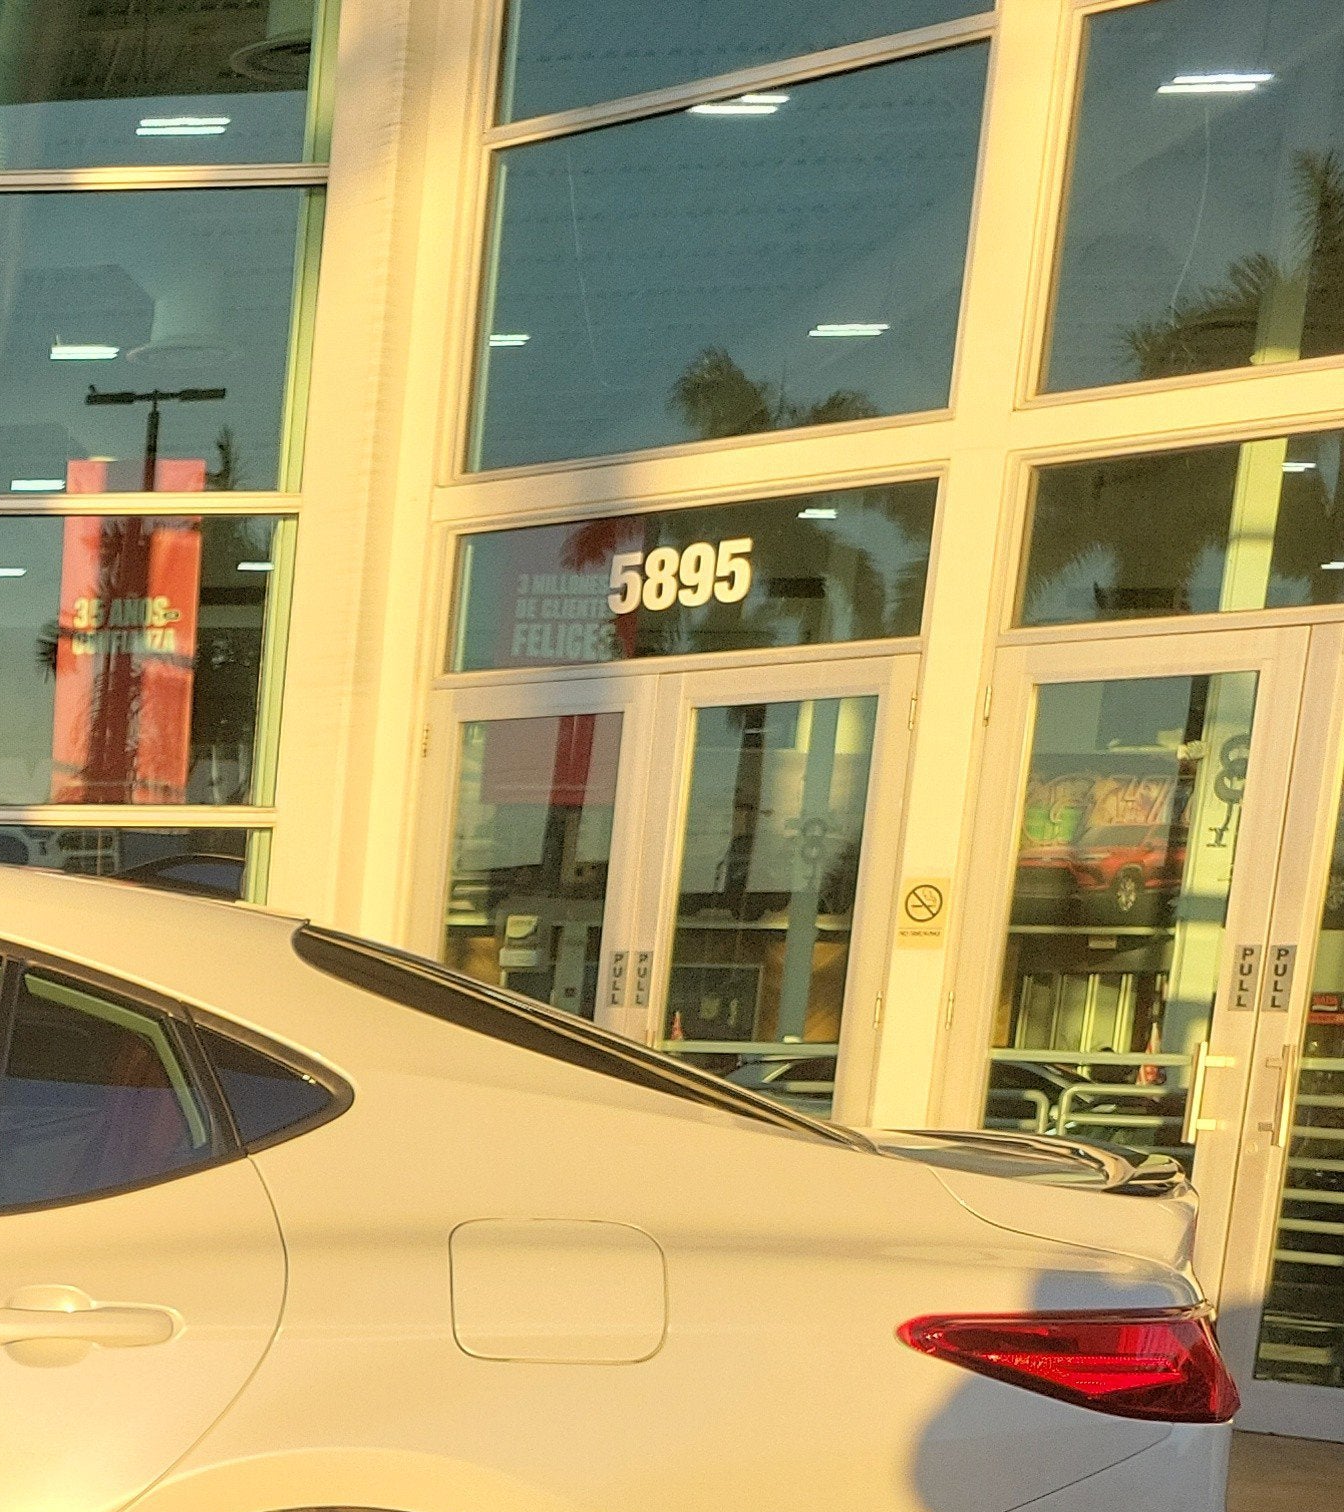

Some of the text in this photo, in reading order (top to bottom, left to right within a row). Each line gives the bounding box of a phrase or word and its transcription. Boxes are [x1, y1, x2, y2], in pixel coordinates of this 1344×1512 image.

[608, 537, 754, 615] 5895
[73, 596, 105, 629] 35
[611, 953, 624, 1006] PULL
[635, 953, 648, 1005] PULL
[1235, 947, 1255, 1008] PULL
[1270, 947, 1290, 1009] PULL
